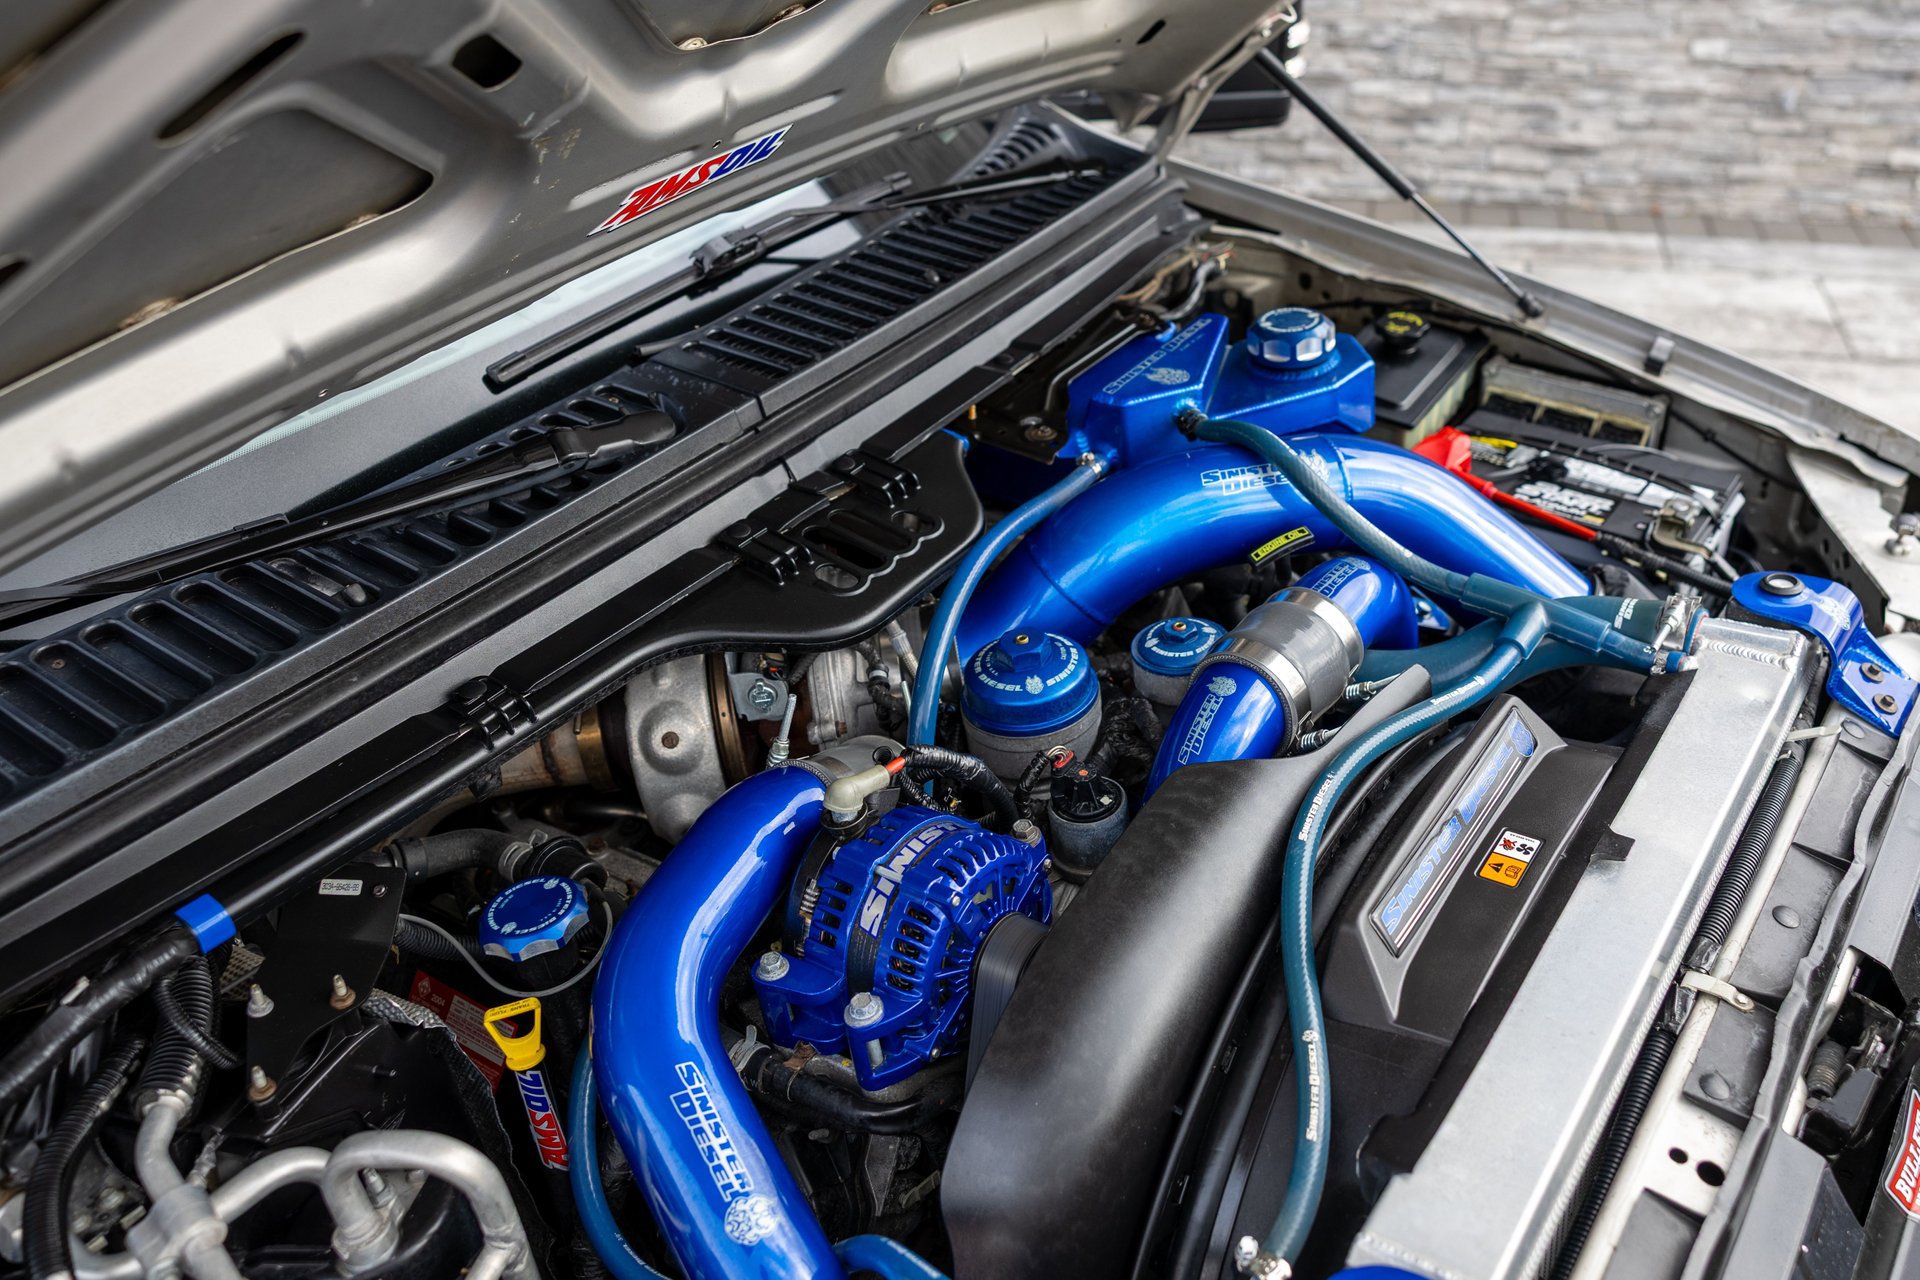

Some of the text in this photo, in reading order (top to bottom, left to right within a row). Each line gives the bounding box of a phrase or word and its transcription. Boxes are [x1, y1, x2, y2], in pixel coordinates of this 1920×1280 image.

[592, 124, 792, 235] AMSOIL
[1102, 350, 1167, 394] SINISTER
[1222, 474, 1290, 496] DIESE
[1311, 561, 1345, 592] INISTER
[1320, 563, 1358, 597] DIESEL
[1045, 647, 1079, 687] SINISTER
[1150, 645, 1194, 657] SINISTER
[978, 673, 1023, 691] DIESEL
[1178, 693, 1216, 765] SINISTER
[1191, 696, 1224, 755] DIESEL
[1381, 742, 1514, 936] SINISTER DIESEL
[516, 1071, 569, 1170] AMSOIL
[669, 1089, 737, 1202] DIESEL
[675, 1061, 754, 1192] SINISTER
